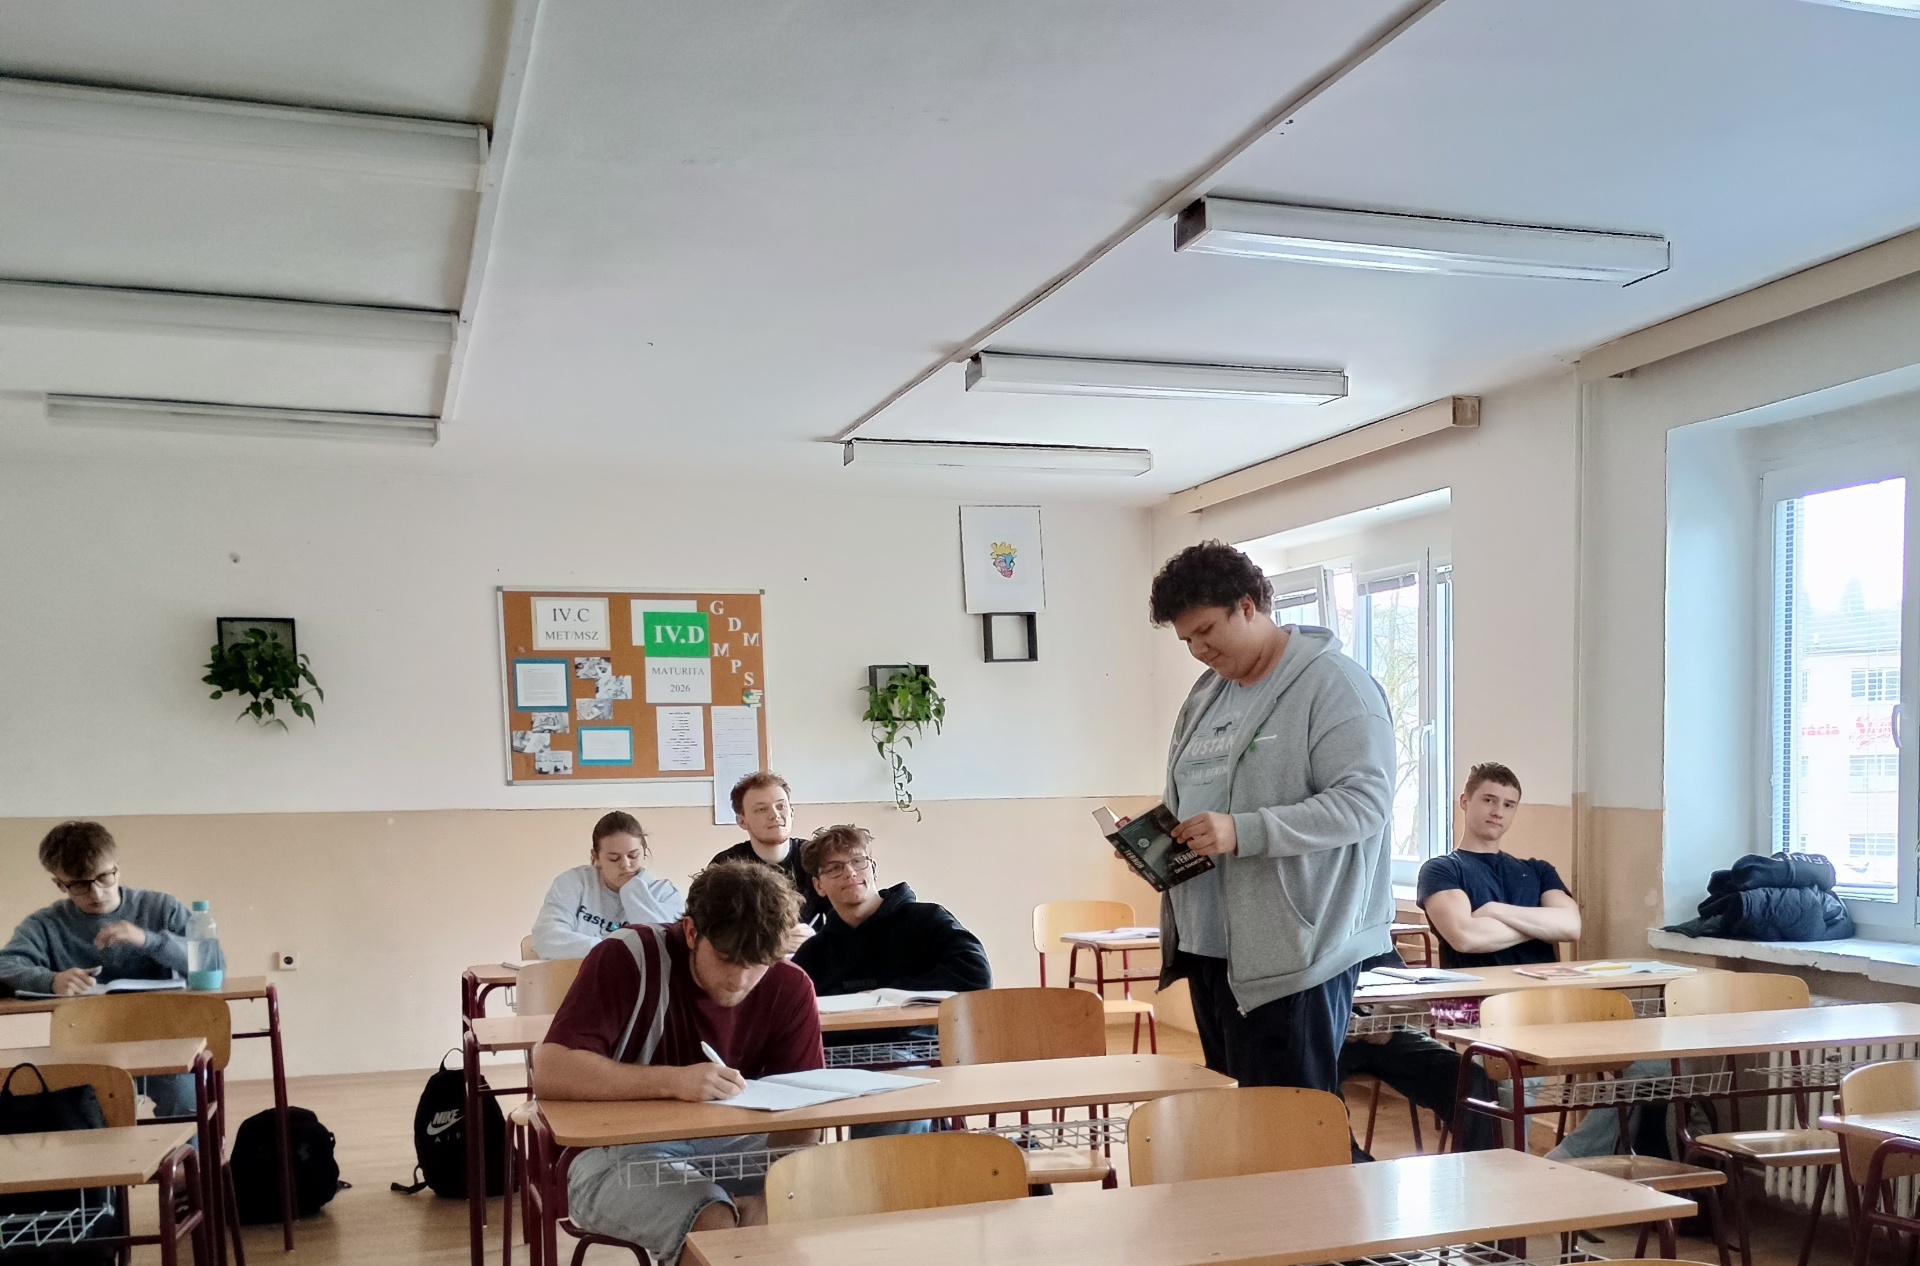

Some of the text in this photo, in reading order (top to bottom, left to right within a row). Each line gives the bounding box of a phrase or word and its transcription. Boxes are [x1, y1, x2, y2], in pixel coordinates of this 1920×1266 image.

[552, 608, 590, 622] IV.C
[545, 630, 599, 641] MET/MSZ
[654, 625, 705, 644] IV.D
[651, 667, 705, 676] MATURITA
[670, 684, 691, 693] 2026
[1174, 849, 1198, 865] TERRO
[432, 1108, 460, 1125] NIKE
[434, 1132, 461, 1144] AIR
